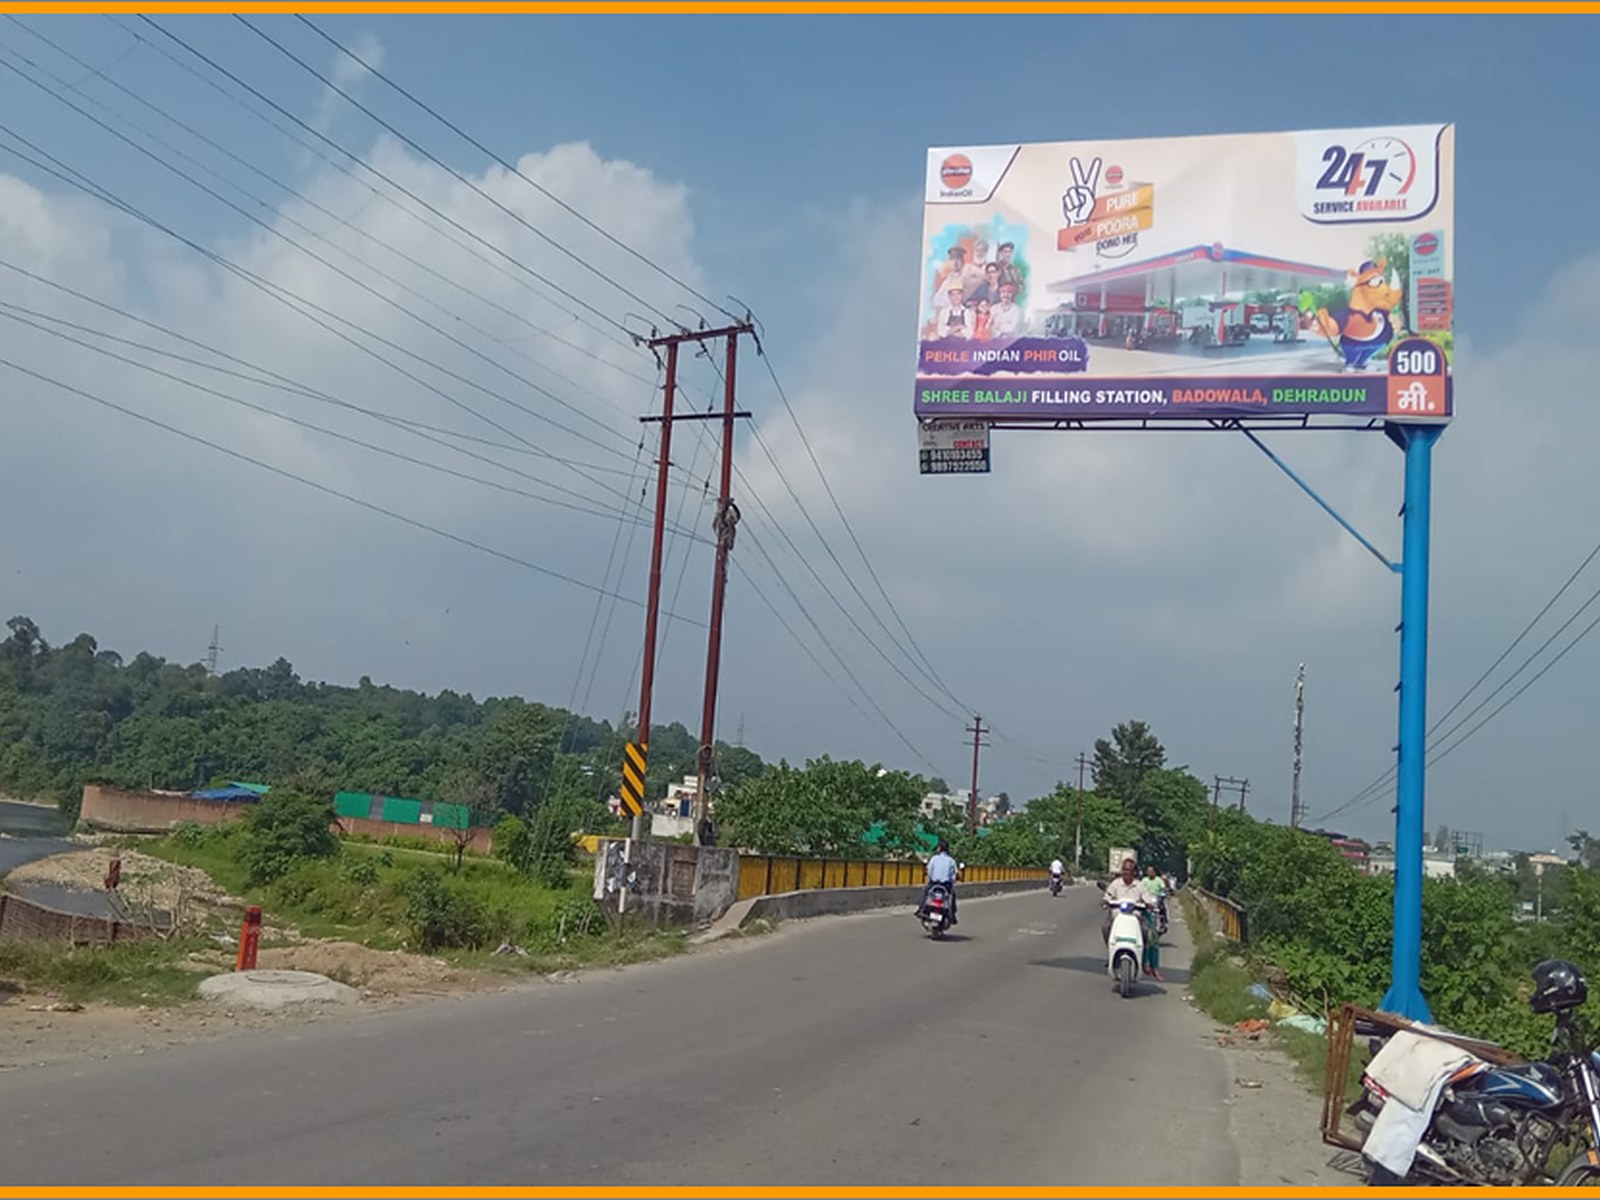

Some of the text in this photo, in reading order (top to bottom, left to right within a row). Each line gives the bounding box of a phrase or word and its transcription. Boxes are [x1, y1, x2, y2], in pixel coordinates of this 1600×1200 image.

[1106, 192, 1139, 212] PURE
[1313, 198, 1407, 214] SERVICE AVAILABLE
[1096, 215, 1139, 237] POORA
[1096, 236, 1120, 251] DONO
[925, 350, 1082, 363] PEHLE INDIAN PHIR OIL
[1397, 351, 1435, 374] 500
[921, 388, 1367, 406] SHREE BALAJI FILLING STATION, BADOWALA, DEHRADUN
[1397, 381, 1435, 411] मी.
[962, 421, 985, 430] ARTS
